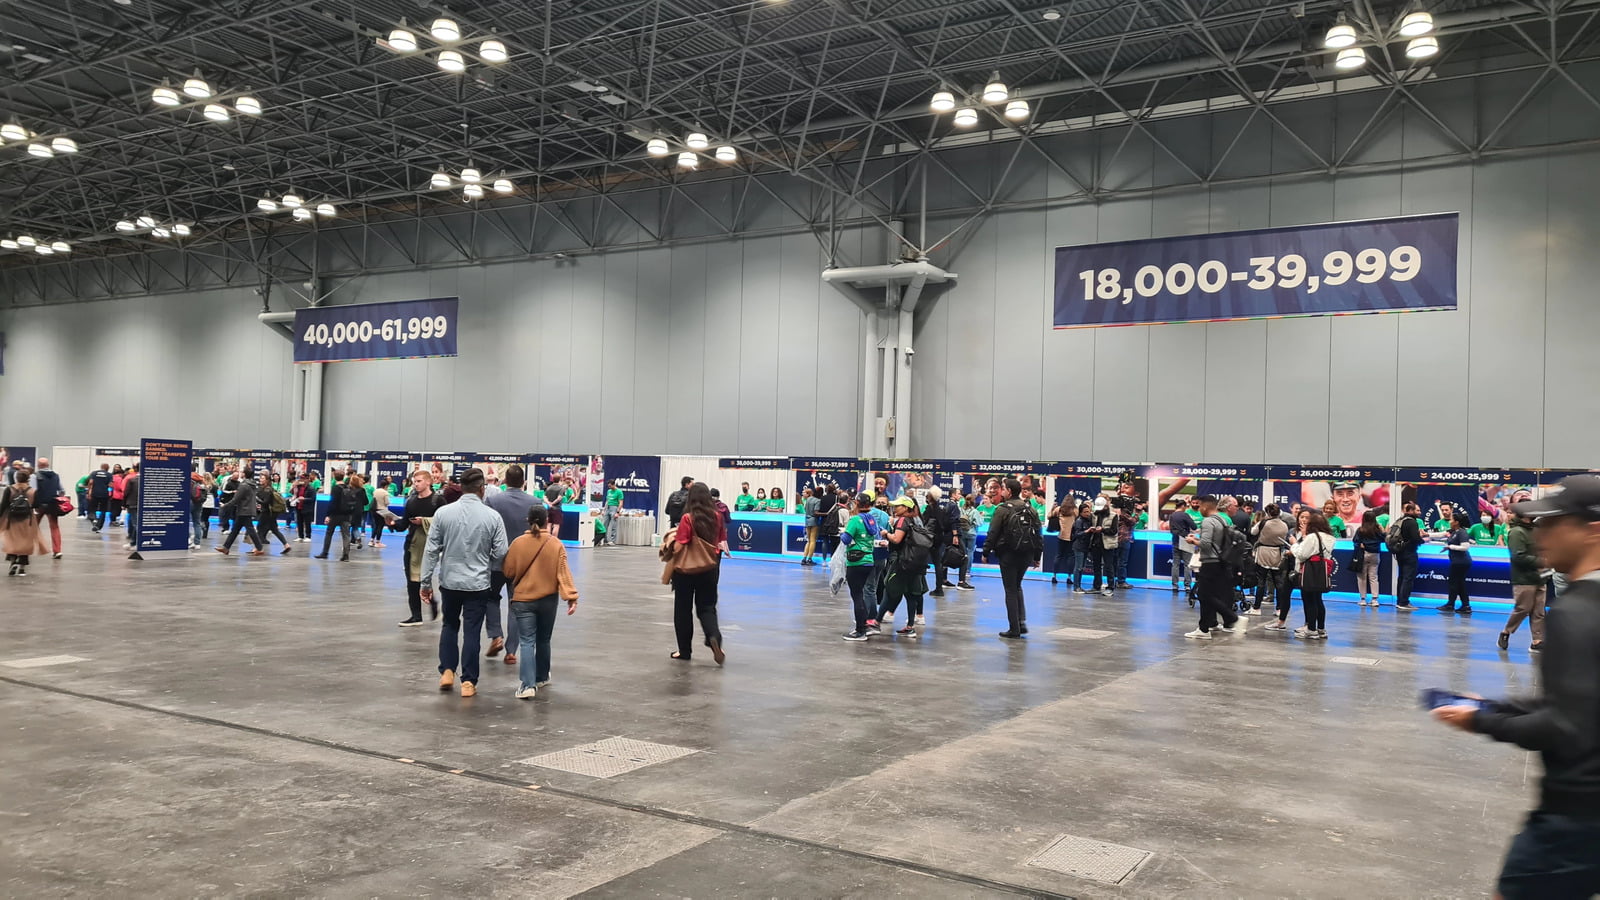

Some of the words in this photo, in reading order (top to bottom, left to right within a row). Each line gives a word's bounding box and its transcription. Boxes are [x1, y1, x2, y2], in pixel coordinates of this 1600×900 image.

[1079, 245, 1422, 305] 18,000-39,999
[303, 315, 447, 348] 40,000-61,999
[817, 472, 832, 480] TCS
[1431, 472, 1499, 480] 24,000-25,999
